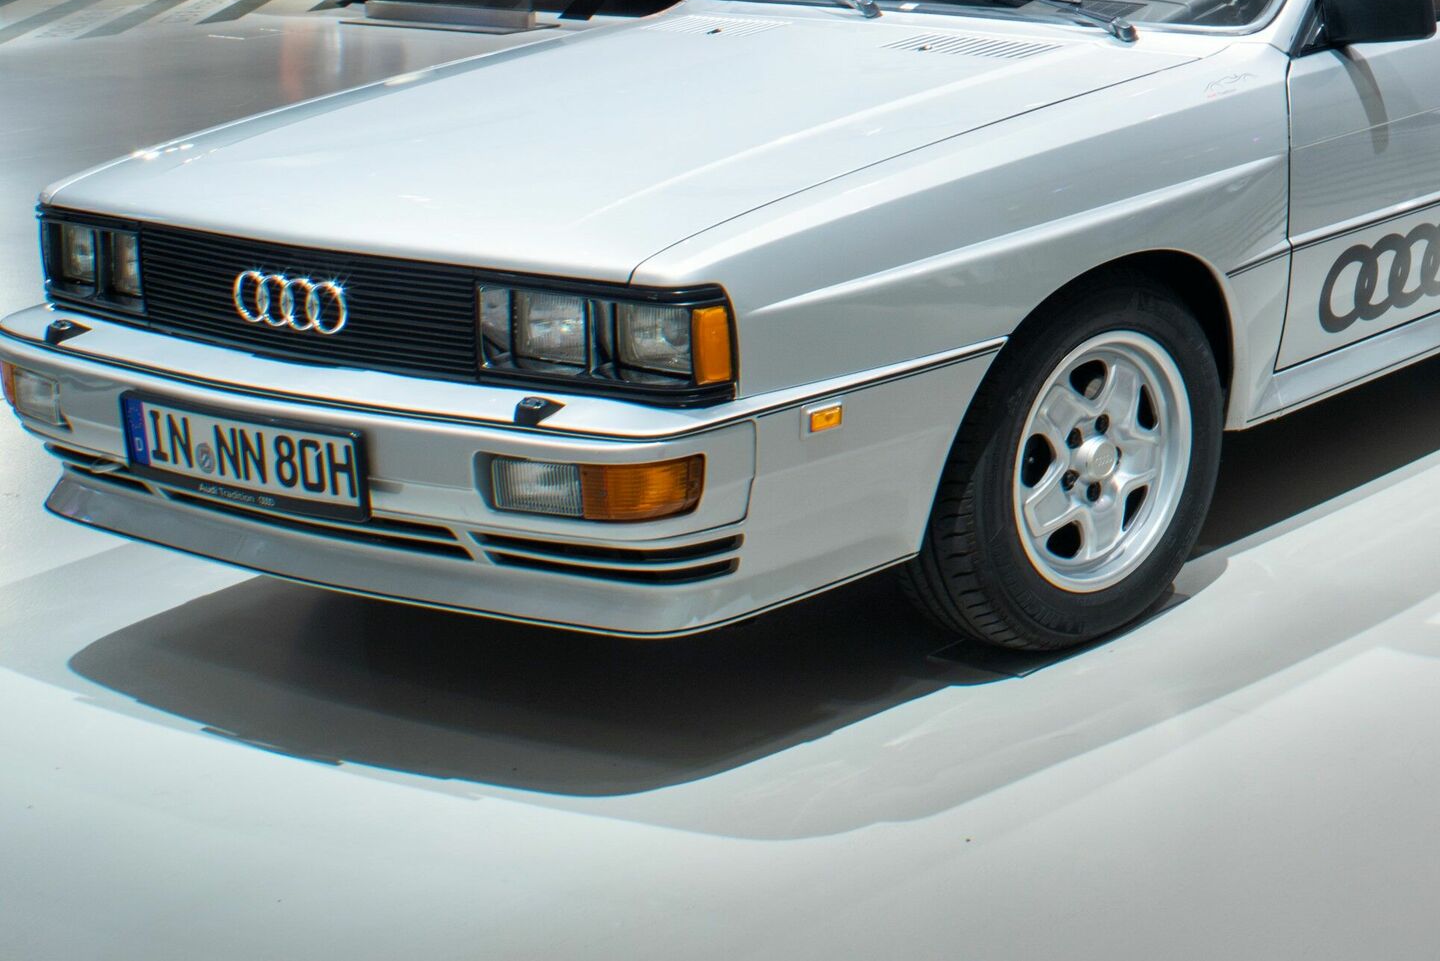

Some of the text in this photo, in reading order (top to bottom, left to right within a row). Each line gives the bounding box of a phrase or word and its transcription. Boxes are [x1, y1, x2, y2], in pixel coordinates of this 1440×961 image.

[149, 409, 194, 468] IN
[213, 423, 268, 484] NN
[199, 482, 256, 502] Audi Tradition
